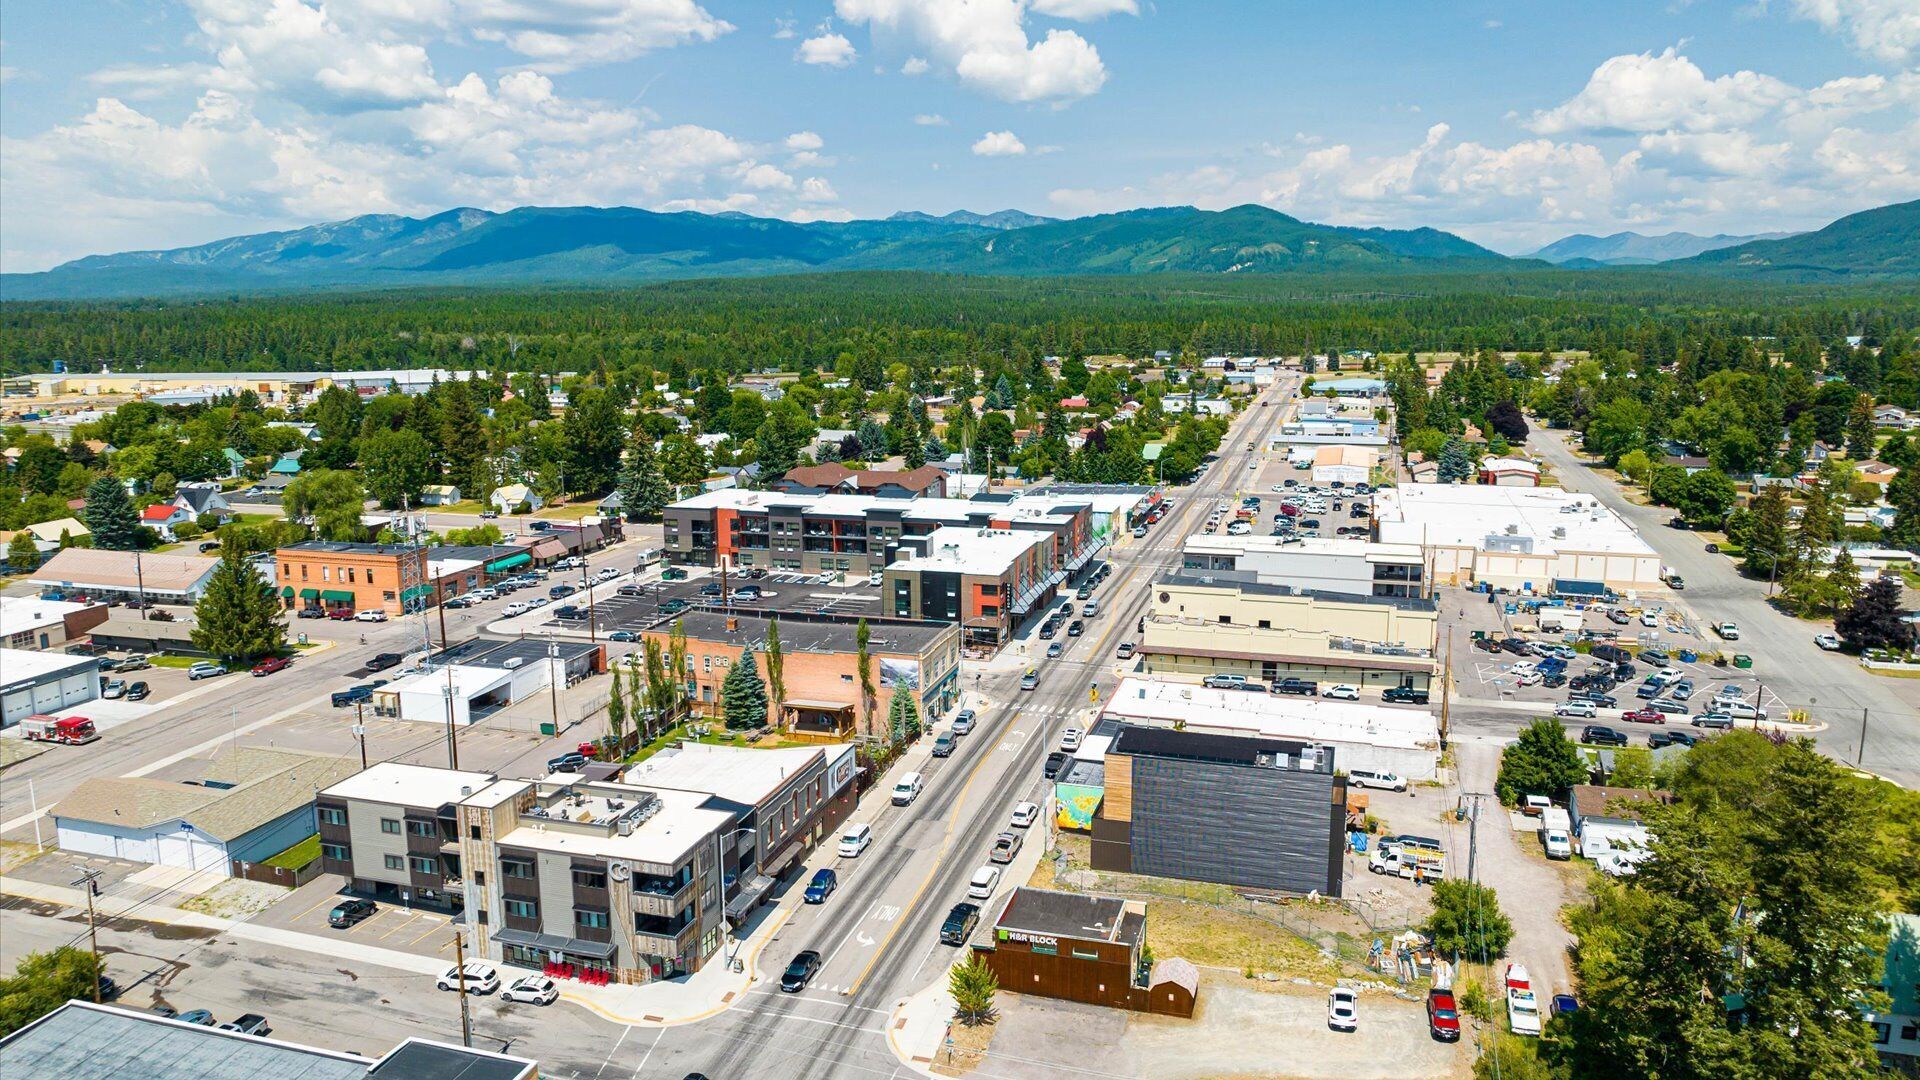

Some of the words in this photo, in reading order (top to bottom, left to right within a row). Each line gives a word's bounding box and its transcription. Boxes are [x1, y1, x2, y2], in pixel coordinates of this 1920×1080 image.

[871, 905, 900, 921] ONLY
[1010, 932, 1028, 942] H&R
[1030, 934, 1058, 946] BLOCK
